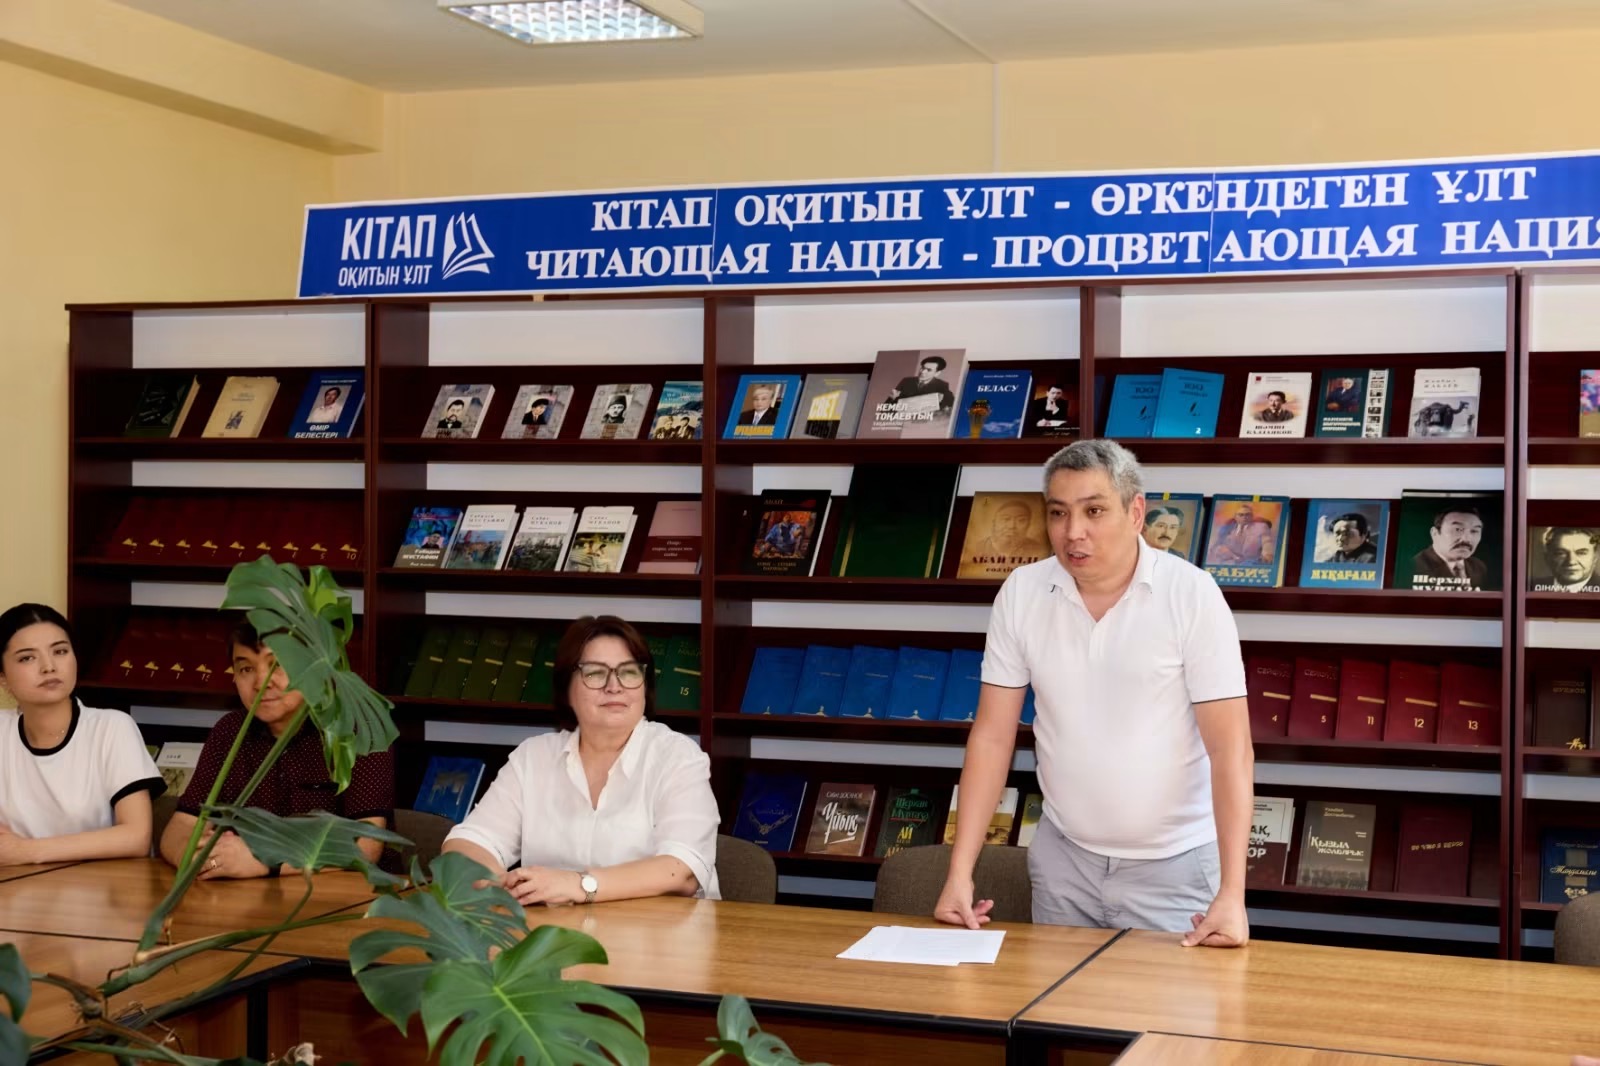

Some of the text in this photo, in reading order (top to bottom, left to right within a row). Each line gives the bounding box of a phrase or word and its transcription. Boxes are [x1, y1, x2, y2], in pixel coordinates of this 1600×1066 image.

[591, 196, 714, 232] КІТАП
[734, 189, 924, 231] ОҚИТЫН
[943, 186, 1035, 219] ҰЛТ
[1091, 172, 1410, 219] ӨРКЕНДЕГЕН
[1432, 166, 1537, 205] ҰЛТ
[340, 214, 437, 261] КІТАП
[525, 243, 771, 282] ЧИТАЮЩАЯ
[788, 238, 944, 278] НАЦИЯ
[991, 223, 1419, 273] ПРОЦВЕТАЮЩАЯ
[338, 264, 433, 289] ОҚИТЫН ҰЛТ
[976, 384, 1020, 393] БЕЛАСУ
[876, 402, 909, 412] КЕМЕЛ
[309, 424, 331, 432] ӨМІР
[1195, 427, 1202, 435] 2
[294, 431, 339, 439] БЕЛЕСТЕРІ
[1412, 574, 1472, 586] Шерхан
[679, 687, 689, 696] 15
[1320, 715, 1327, 723] 5
[1367, 716, 1375, 726] 11
[1413, 717, 1425, 729] 12
[1467, 719, 1479, 731] 13
